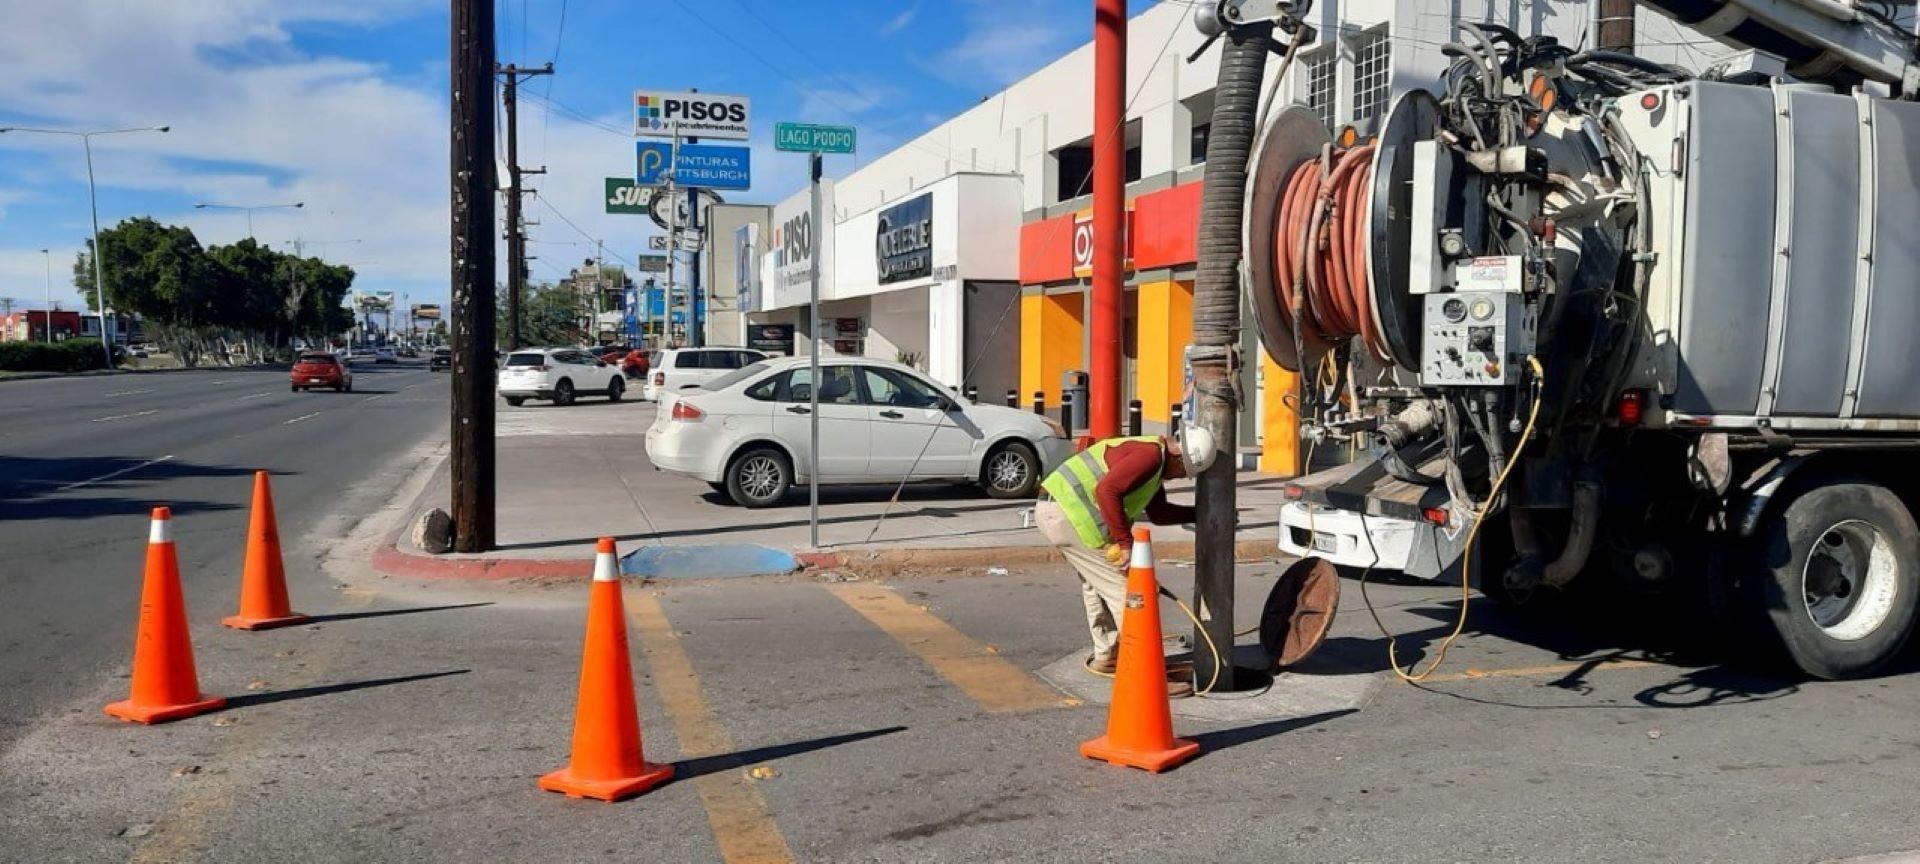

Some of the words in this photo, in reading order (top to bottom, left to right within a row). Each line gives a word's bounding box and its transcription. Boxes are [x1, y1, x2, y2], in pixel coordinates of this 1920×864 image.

[664, 99, 746, 122] PISOS
[780, 129, 809, 145] LAGO
[664, 168, 747, 179] TTSBURGH
[608, 187, 658, 205] SUB
[783, 210, 811, 267] PISO
